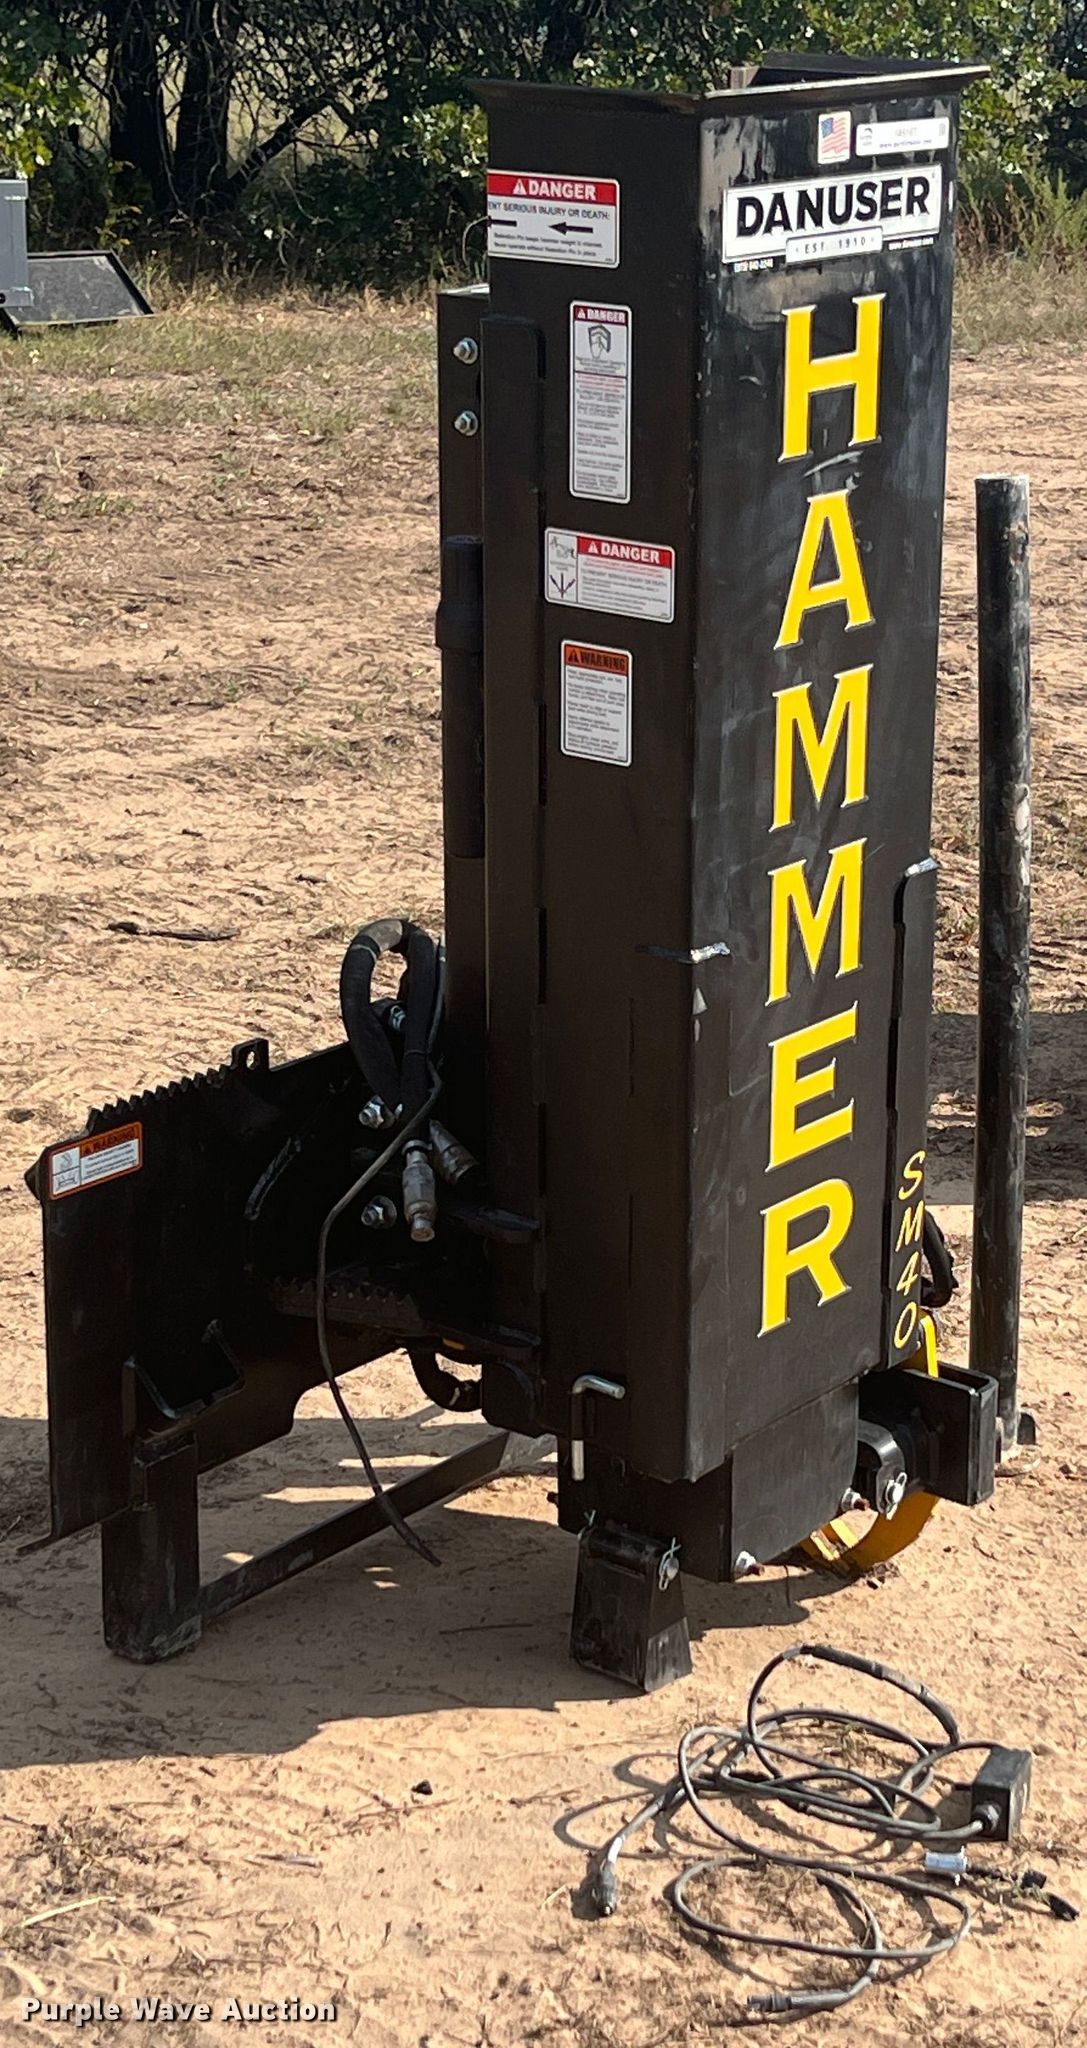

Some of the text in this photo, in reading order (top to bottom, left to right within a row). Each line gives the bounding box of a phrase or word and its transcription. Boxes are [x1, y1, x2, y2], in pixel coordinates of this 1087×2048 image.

[528, 180, 597, 200] DANGER
[503, 203, 537, 213] SERIOUS
[539, 206, 566, 216] INJURY
[736, 176, 930, 238] DANUSER
[587, 308, 626, 323] DANGER
[600, 542, 660, 564] DANGER
[580, 650, 626, 672] WARNING
[757, 292, 887, 1338] HAMMER
[893, 1150, 926, 1349] SM40
